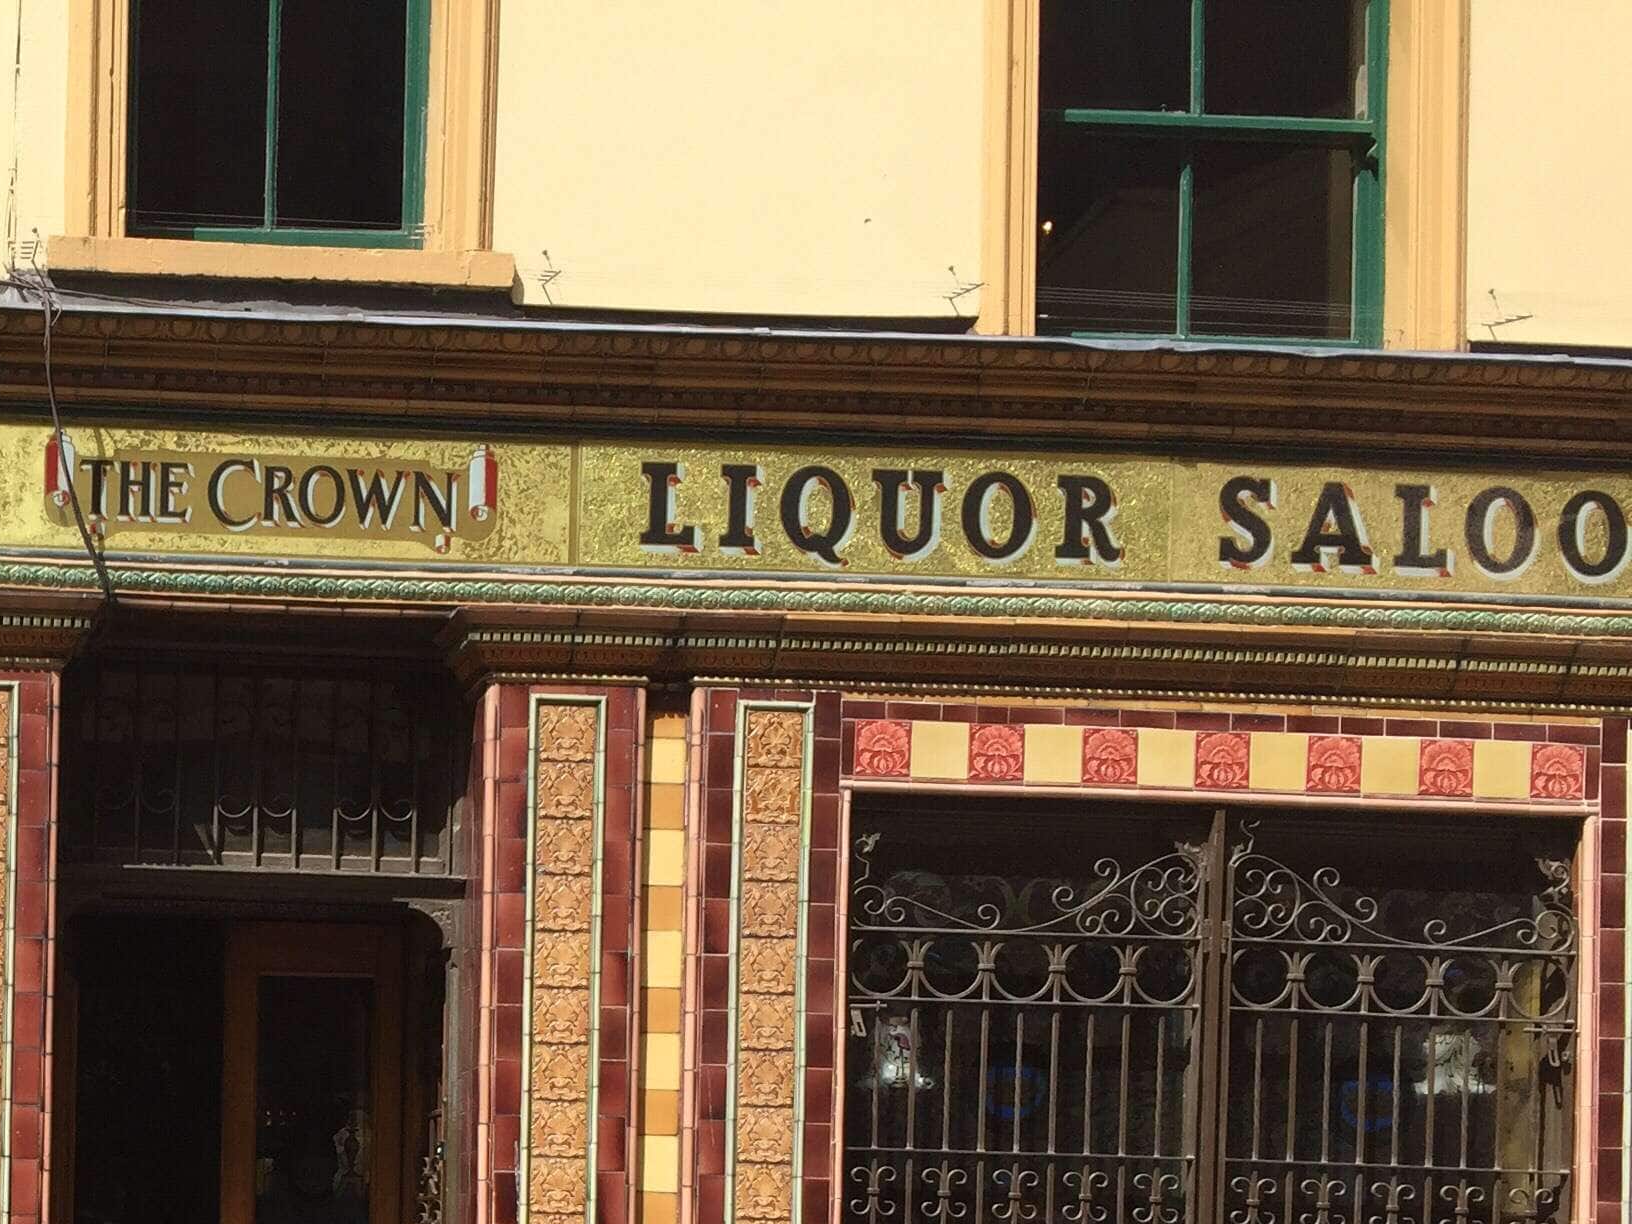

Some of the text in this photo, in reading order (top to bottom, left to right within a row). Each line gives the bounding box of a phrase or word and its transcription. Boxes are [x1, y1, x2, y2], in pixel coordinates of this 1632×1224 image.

[79, 456, 462, 535] THE CROWN
[638, 460, 1632, 584] LIQUOR SALOO
